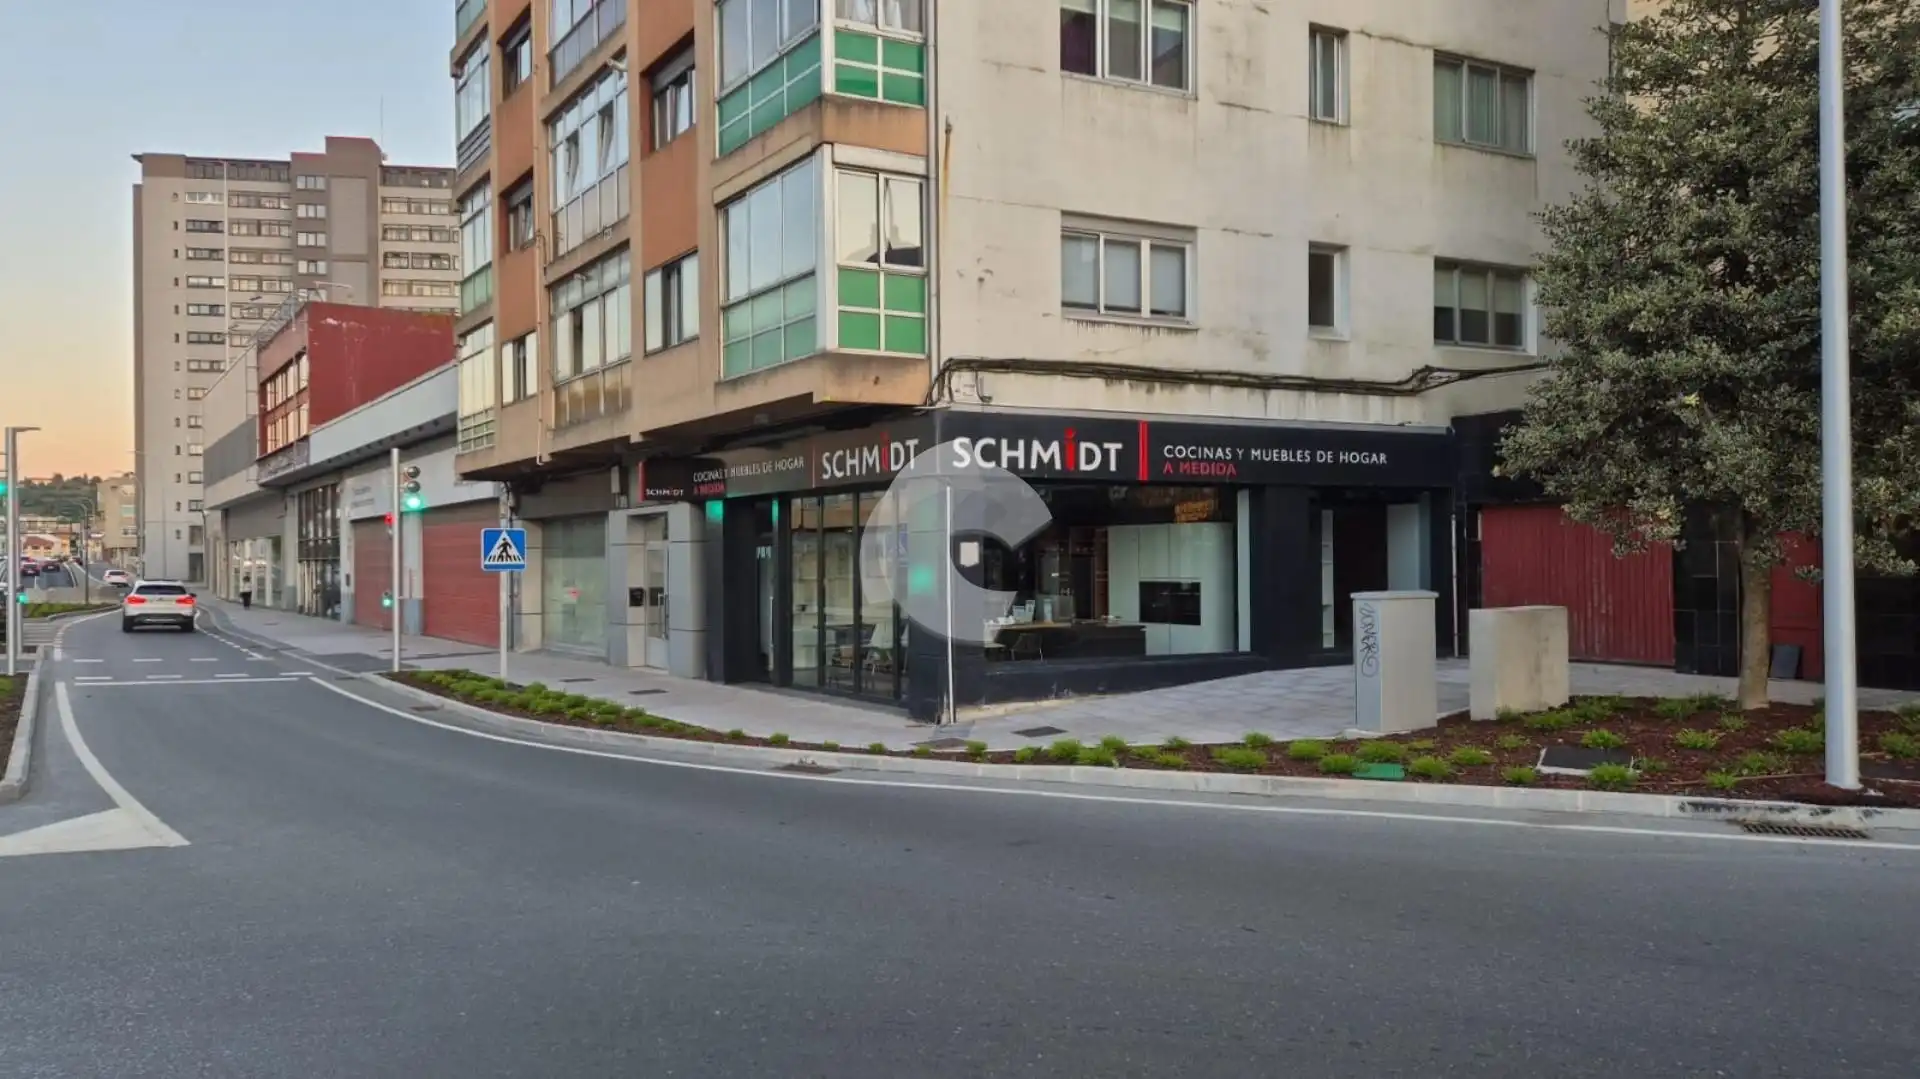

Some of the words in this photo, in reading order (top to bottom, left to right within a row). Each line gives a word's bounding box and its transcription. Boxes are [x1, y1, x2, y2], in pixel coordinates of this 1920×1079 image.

[1163, 444, 1232, 460] COCINAS
[1236, 447, 1245, 460] Y
[1251, 447, 1311, 462] MUEBLES
[1316, 449, 1334, 463] DE
[1339, 450, 1388, 465] HOGAR
[763, 461, 773, 473] DE
[775, 456, 805, 471] HOGAR
[1163, 461, 1173, 475] A
[1179, 461, 1237, 476] MEDIDA
